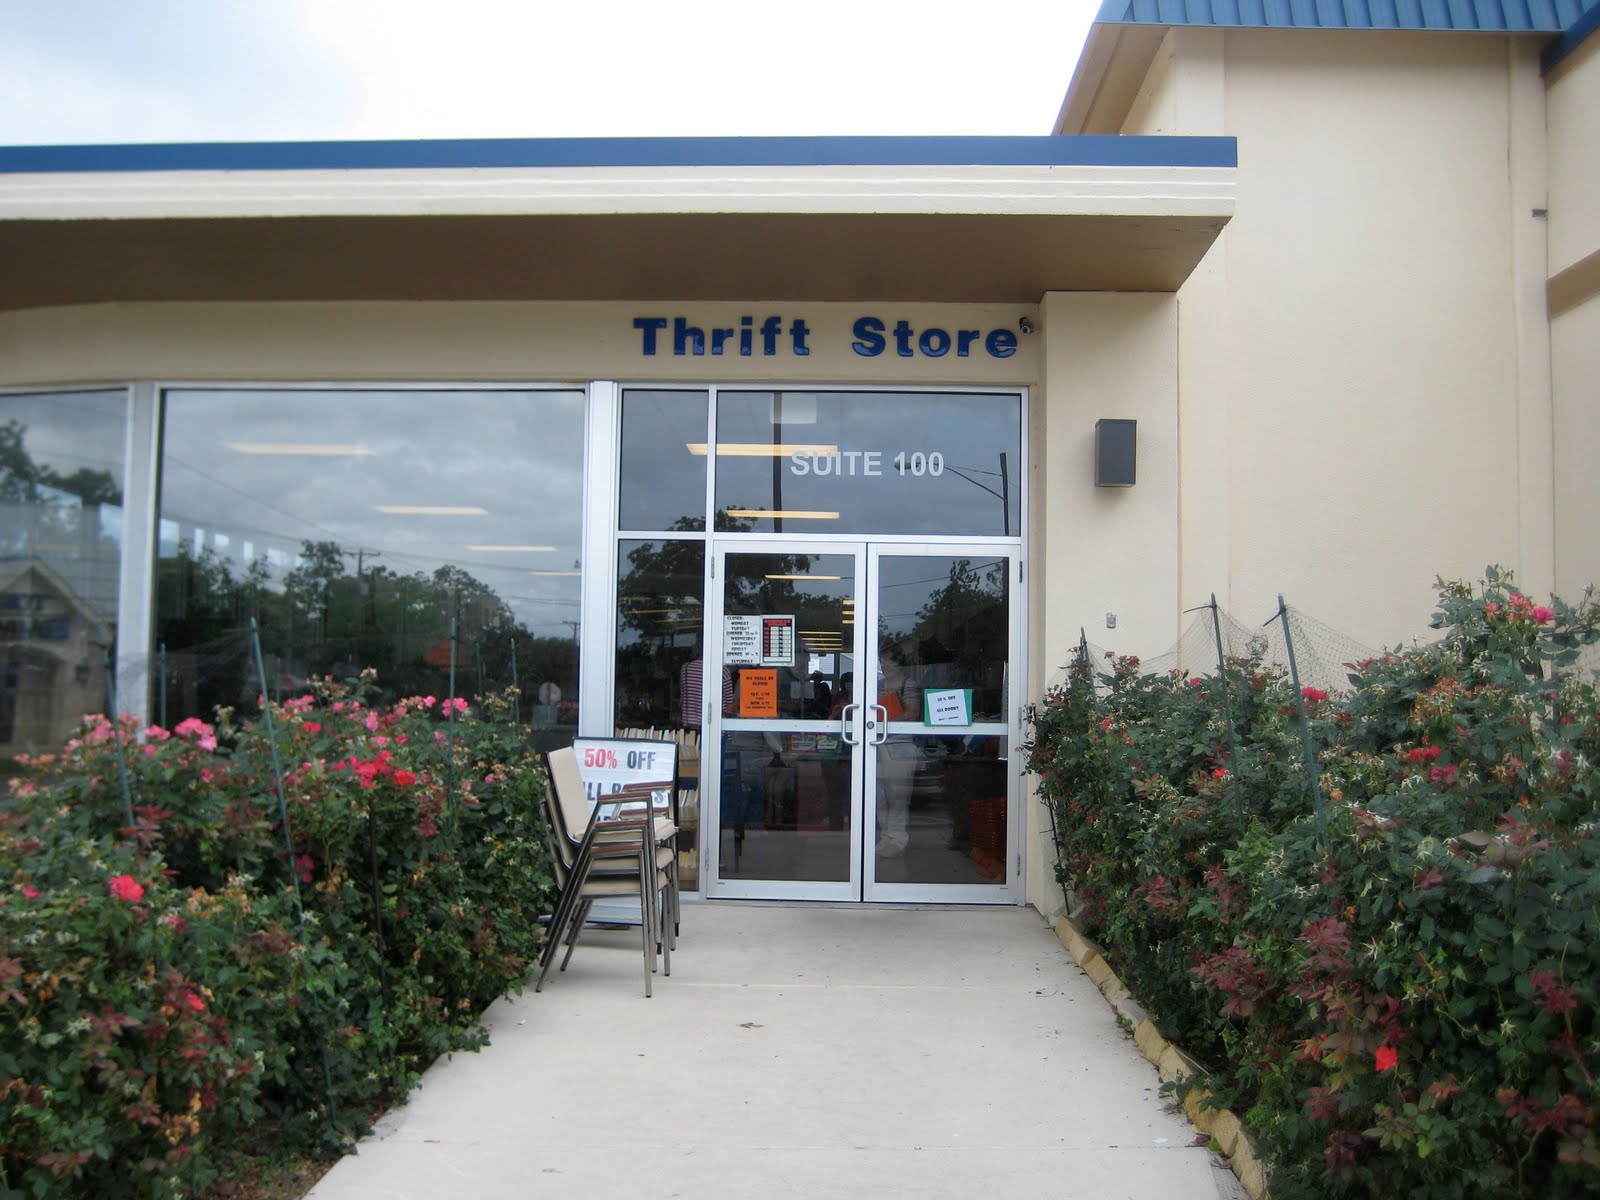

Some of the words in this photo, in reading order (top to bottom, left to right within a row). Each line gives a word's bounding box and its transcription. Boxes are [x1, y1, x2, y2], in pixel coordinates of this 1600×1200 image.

[633, 315, 811, 357] Thrift
[852, 316, 1018, 358] Store
[790, 450, 883, 477] SUITE
[895, 451, 944, 477] 100
[584, 748, 618, 769] 50%
[627, 750, 656, 770] OFF
[583, 781, 602, 801] LL
